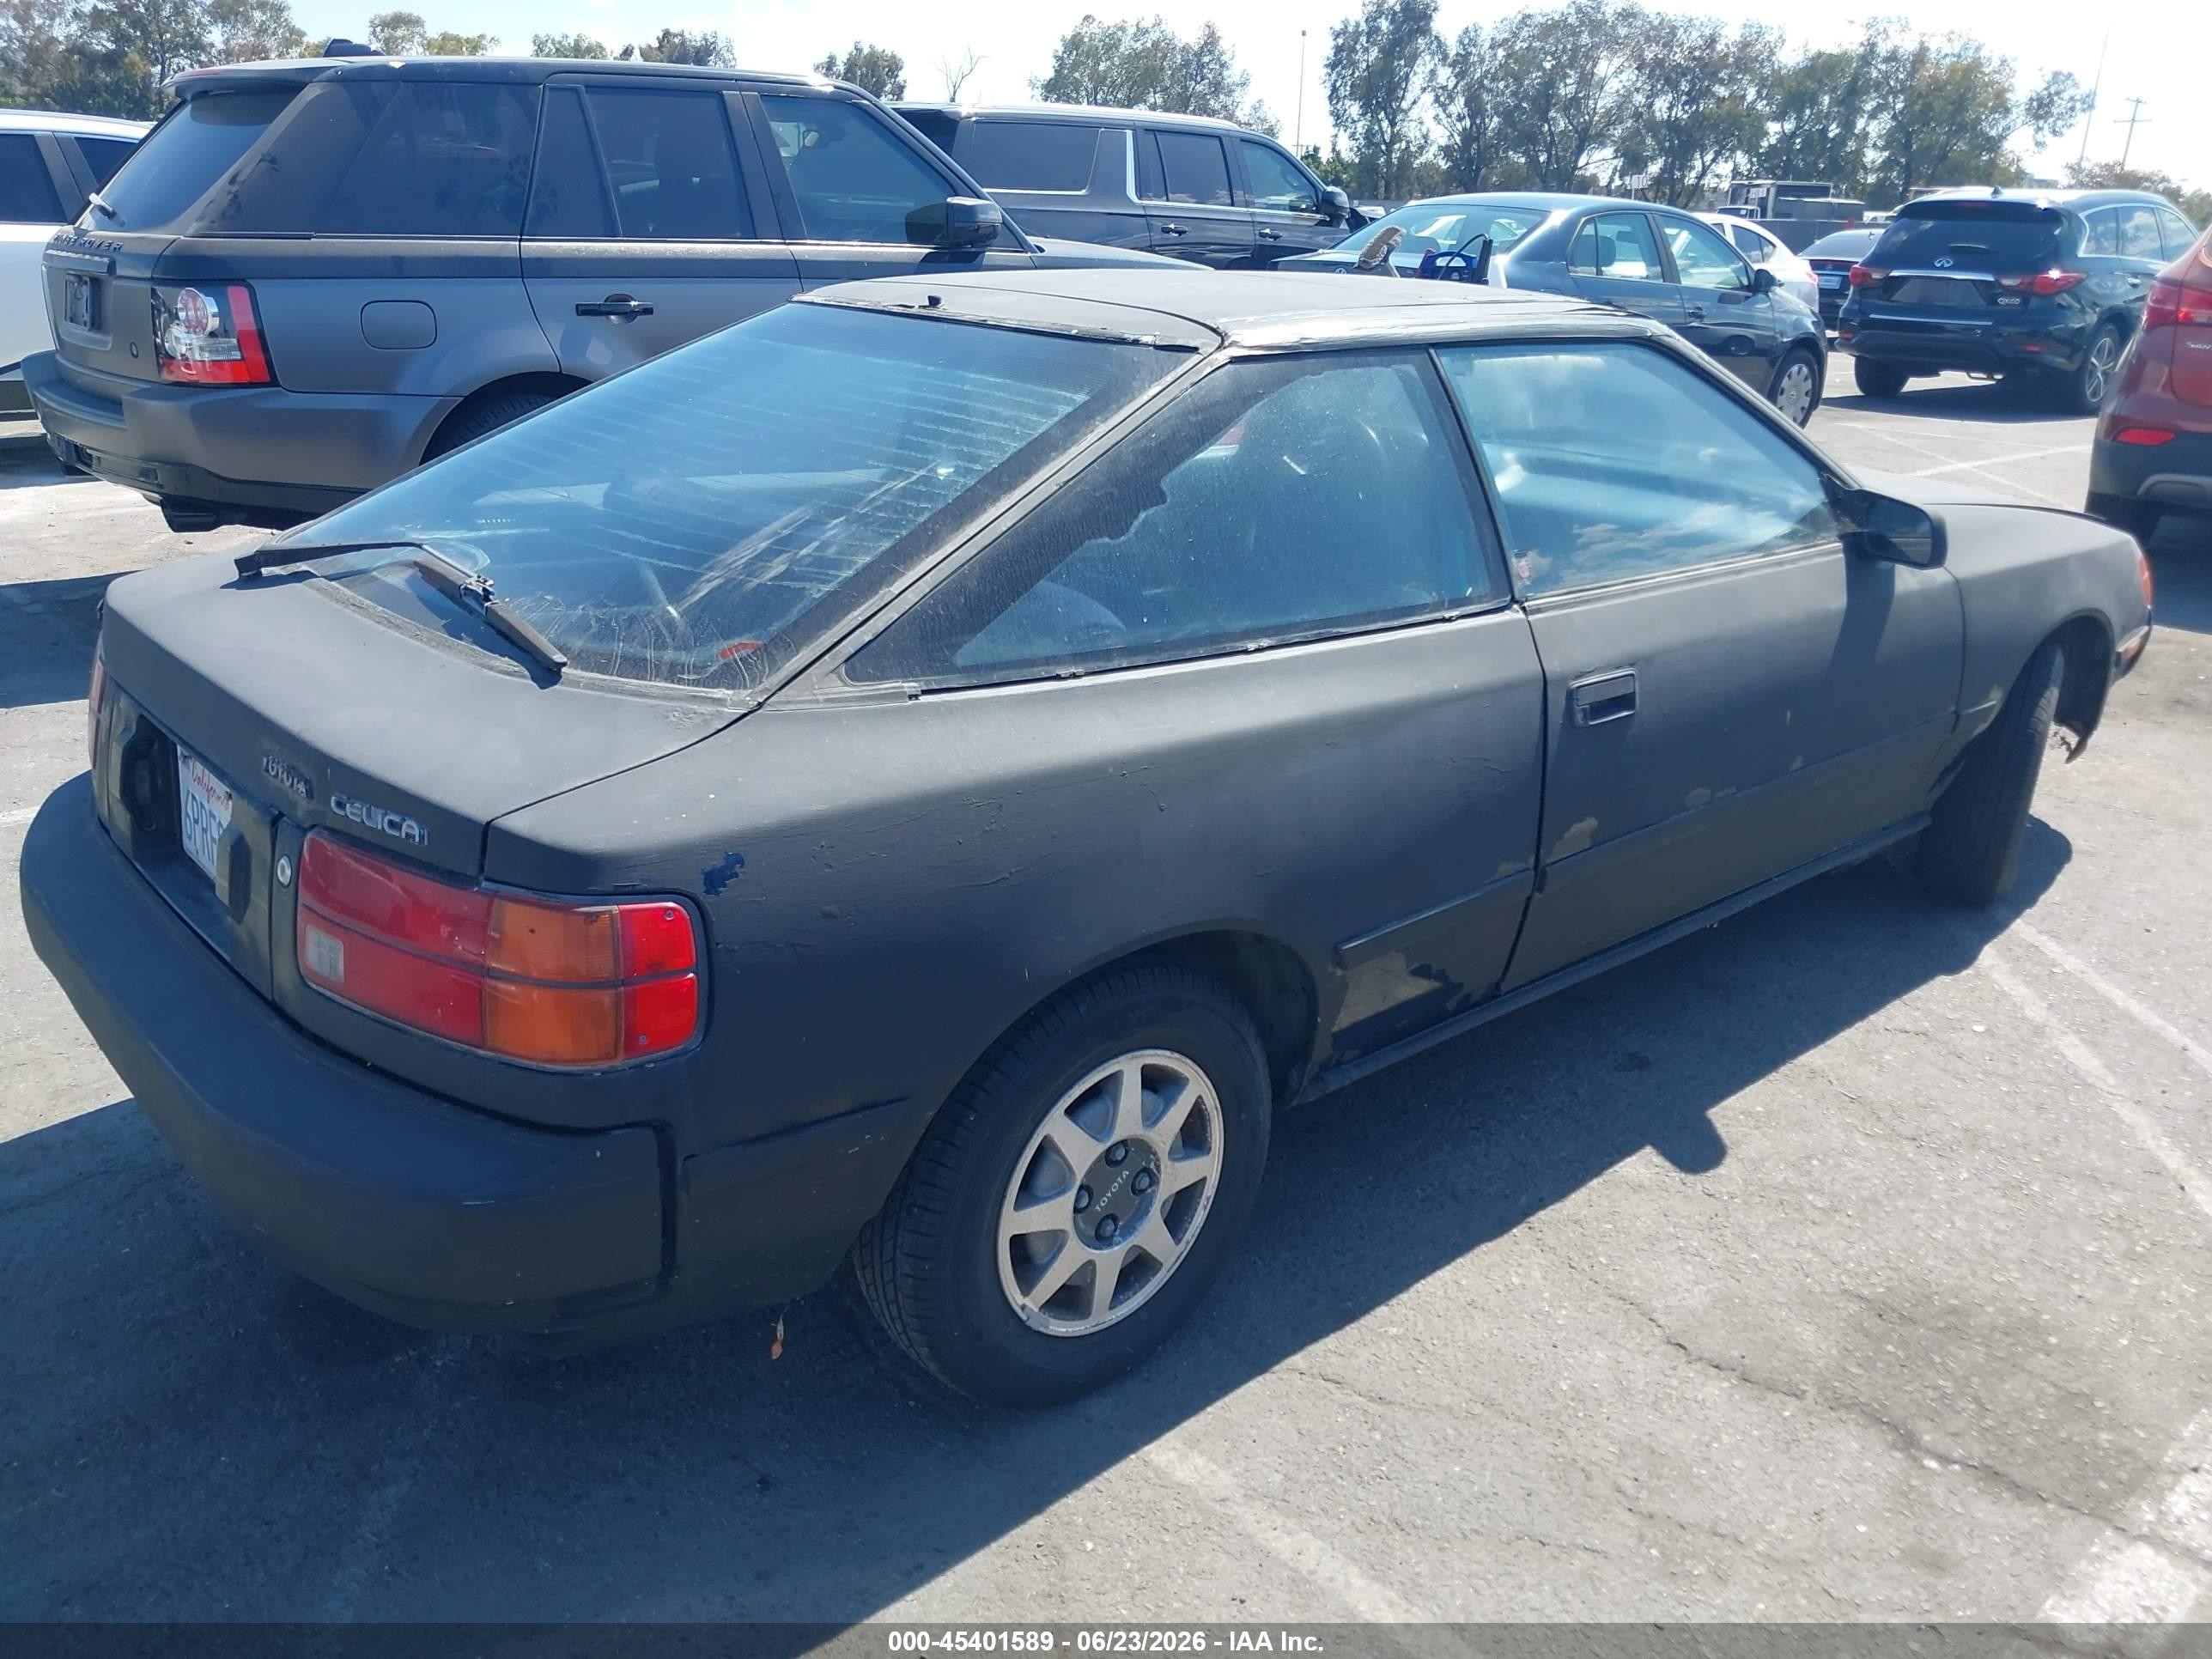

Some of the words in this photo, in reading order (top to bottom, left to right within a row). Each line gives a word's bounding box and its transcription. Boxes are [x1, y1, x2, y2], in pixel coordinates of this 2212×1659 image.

[80, 237, 123, 252] ROVER
[2185, 341, 2212, 350] SAN
[262, 756, 311, 798] TOYOTA
[1094, 1169, 1130, 1212] TOYOTA
